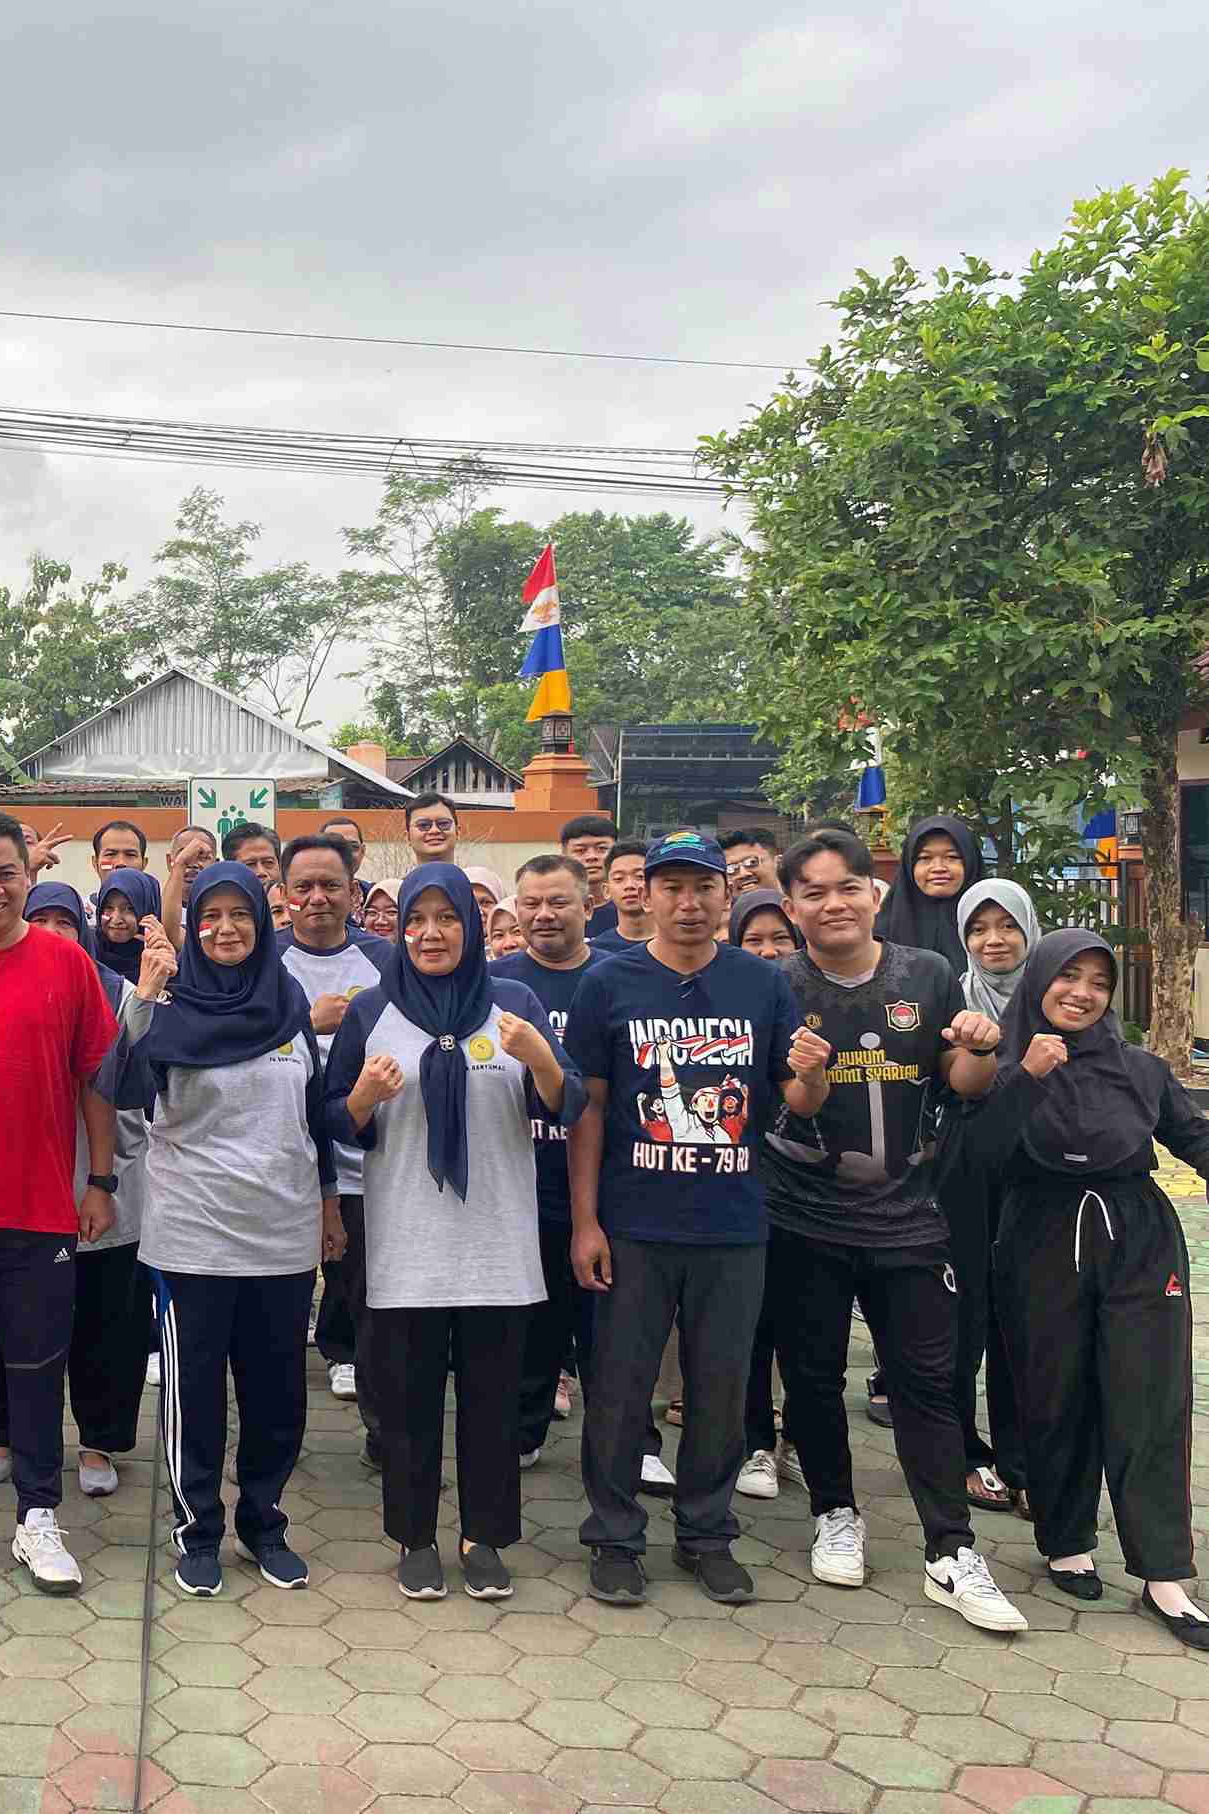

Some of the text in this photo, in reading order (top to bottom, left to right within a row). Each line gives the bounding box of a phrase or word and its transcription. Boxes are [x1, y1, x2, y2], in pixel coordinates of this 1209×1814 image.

[837, 1049, 886, 1066] HUKUM
[823, 1064, 919, 1084] NOMI SYARIAH
[632, 1142, 668, 1171] HUT
[671, 1145, 697, 1173] KE
[715, 1146, 735, 1174] 79
